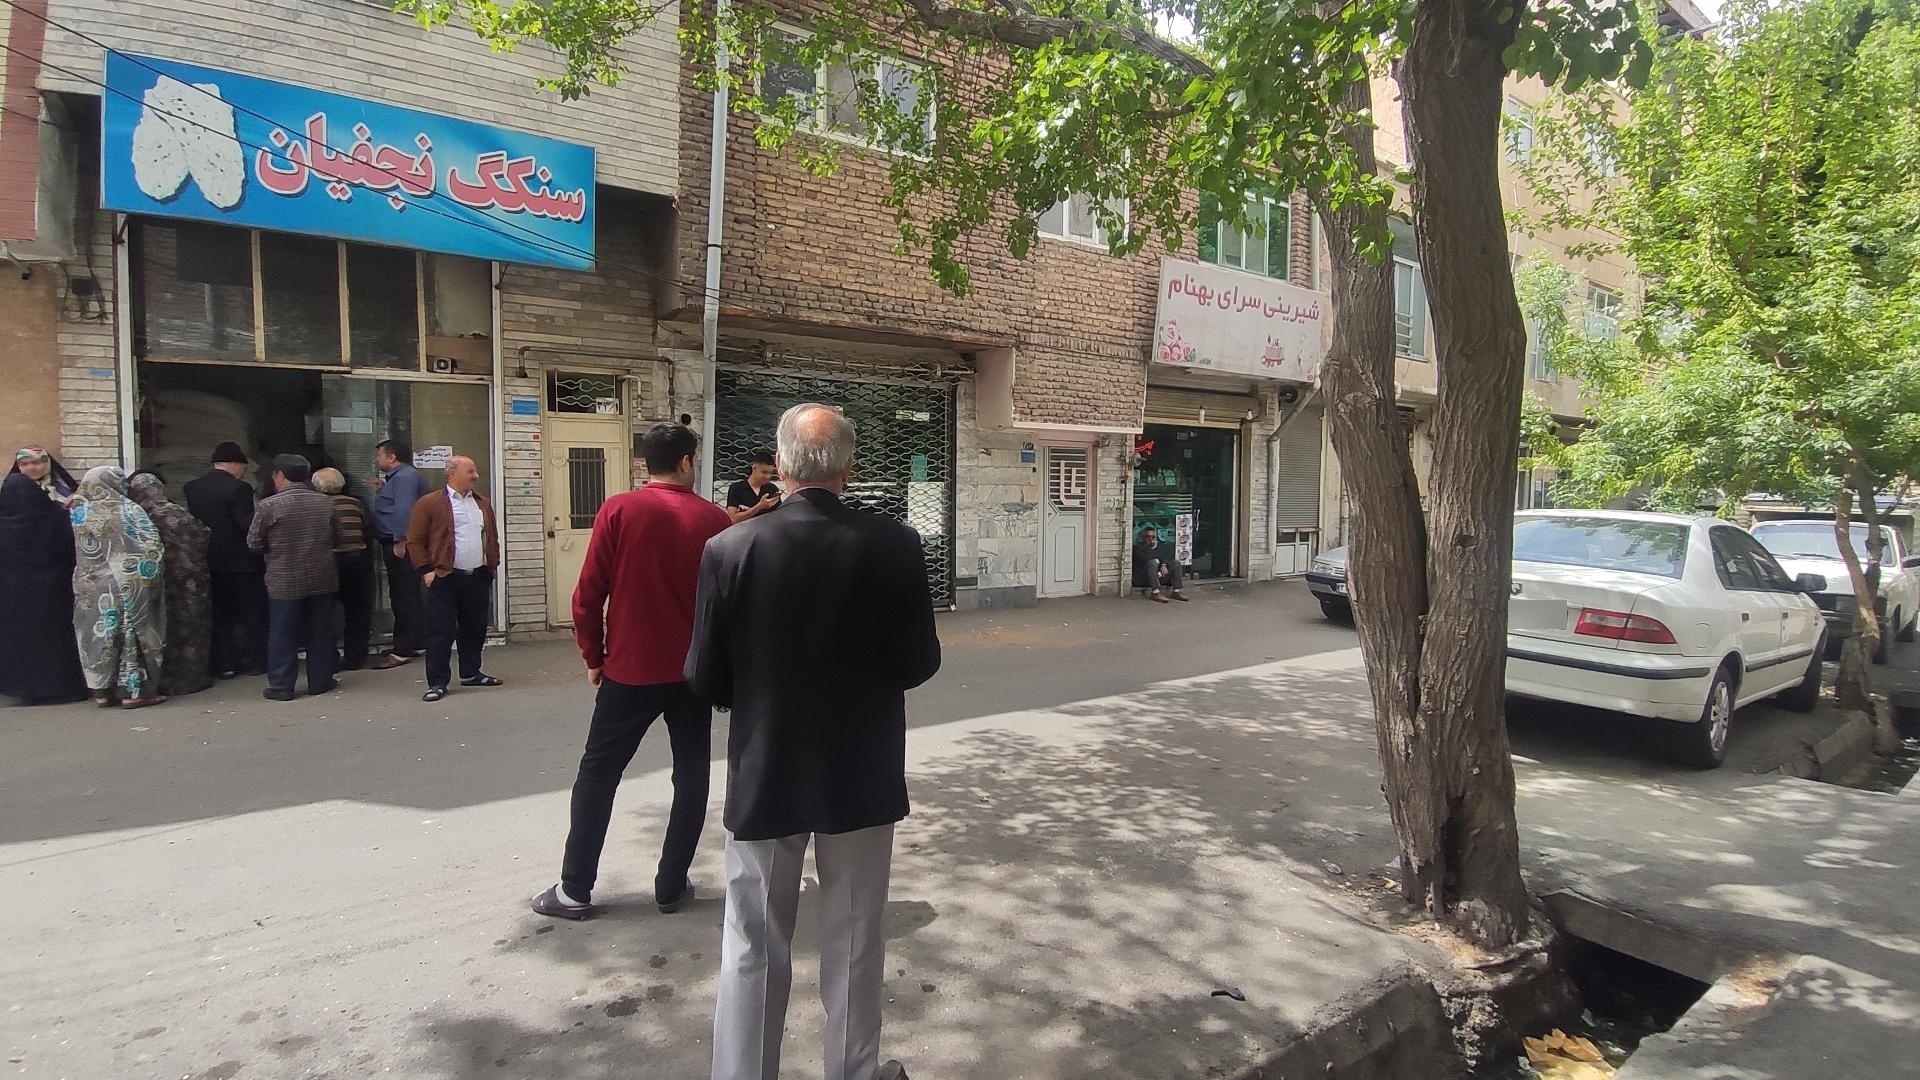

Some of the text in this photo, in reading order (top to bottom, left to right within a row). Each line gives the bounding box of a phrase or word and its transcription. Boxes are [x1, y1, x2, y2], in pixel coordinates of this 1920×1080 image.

[255, 111, 437, 211] نجفیان
[1167, 273, 1320, 324] شیرینی سرای بهنام
